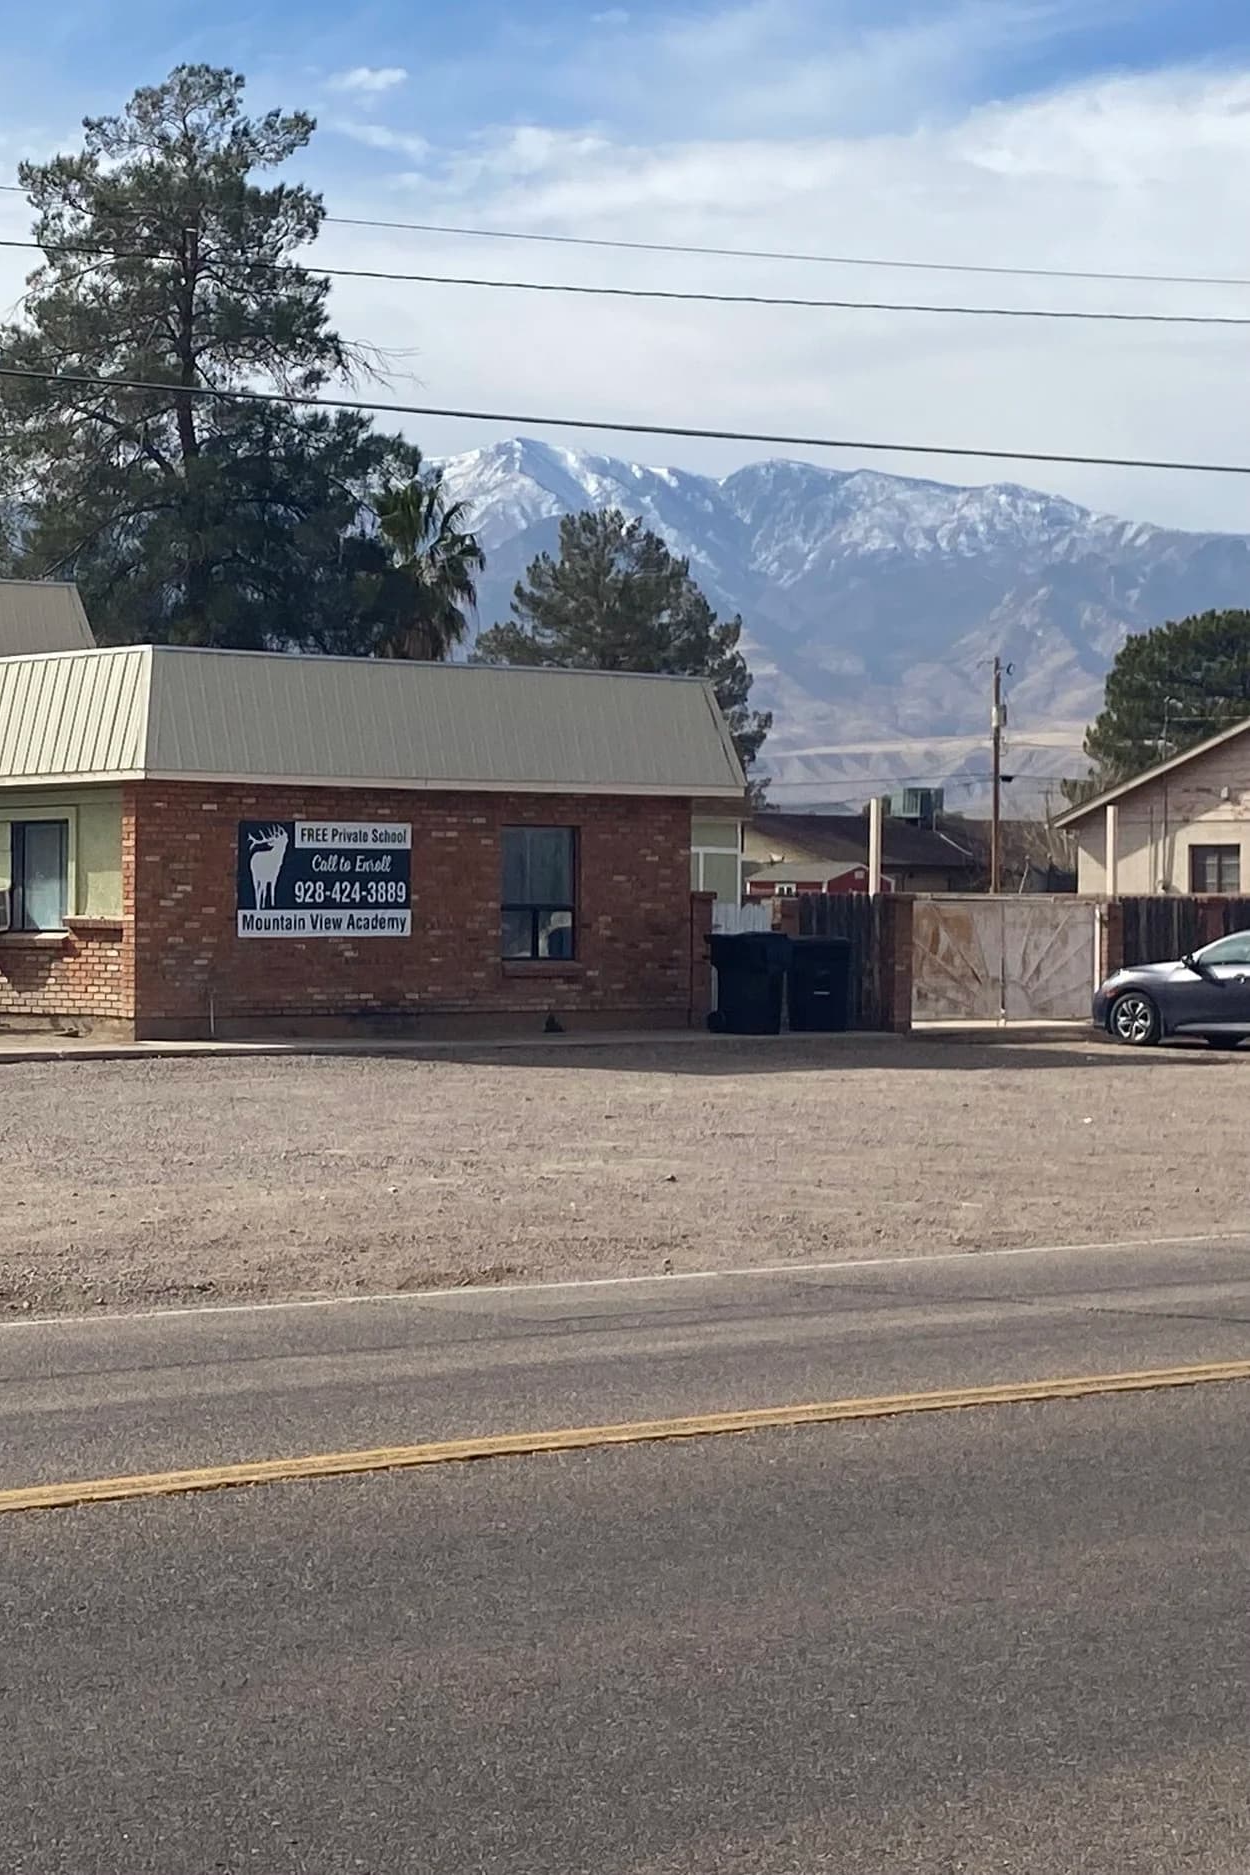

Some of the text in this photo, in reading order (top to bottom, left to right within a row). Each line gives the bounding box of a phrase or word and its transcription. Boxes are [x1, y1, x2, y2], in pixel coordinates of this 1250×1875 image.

[300, 827, 407, 843] FREE Private School
[311, 854, 392, 873] Call to Enroll
[294, 881, 407, 903] 928-424-3889
[242, 914, 407, 933] Mountain View Academy
